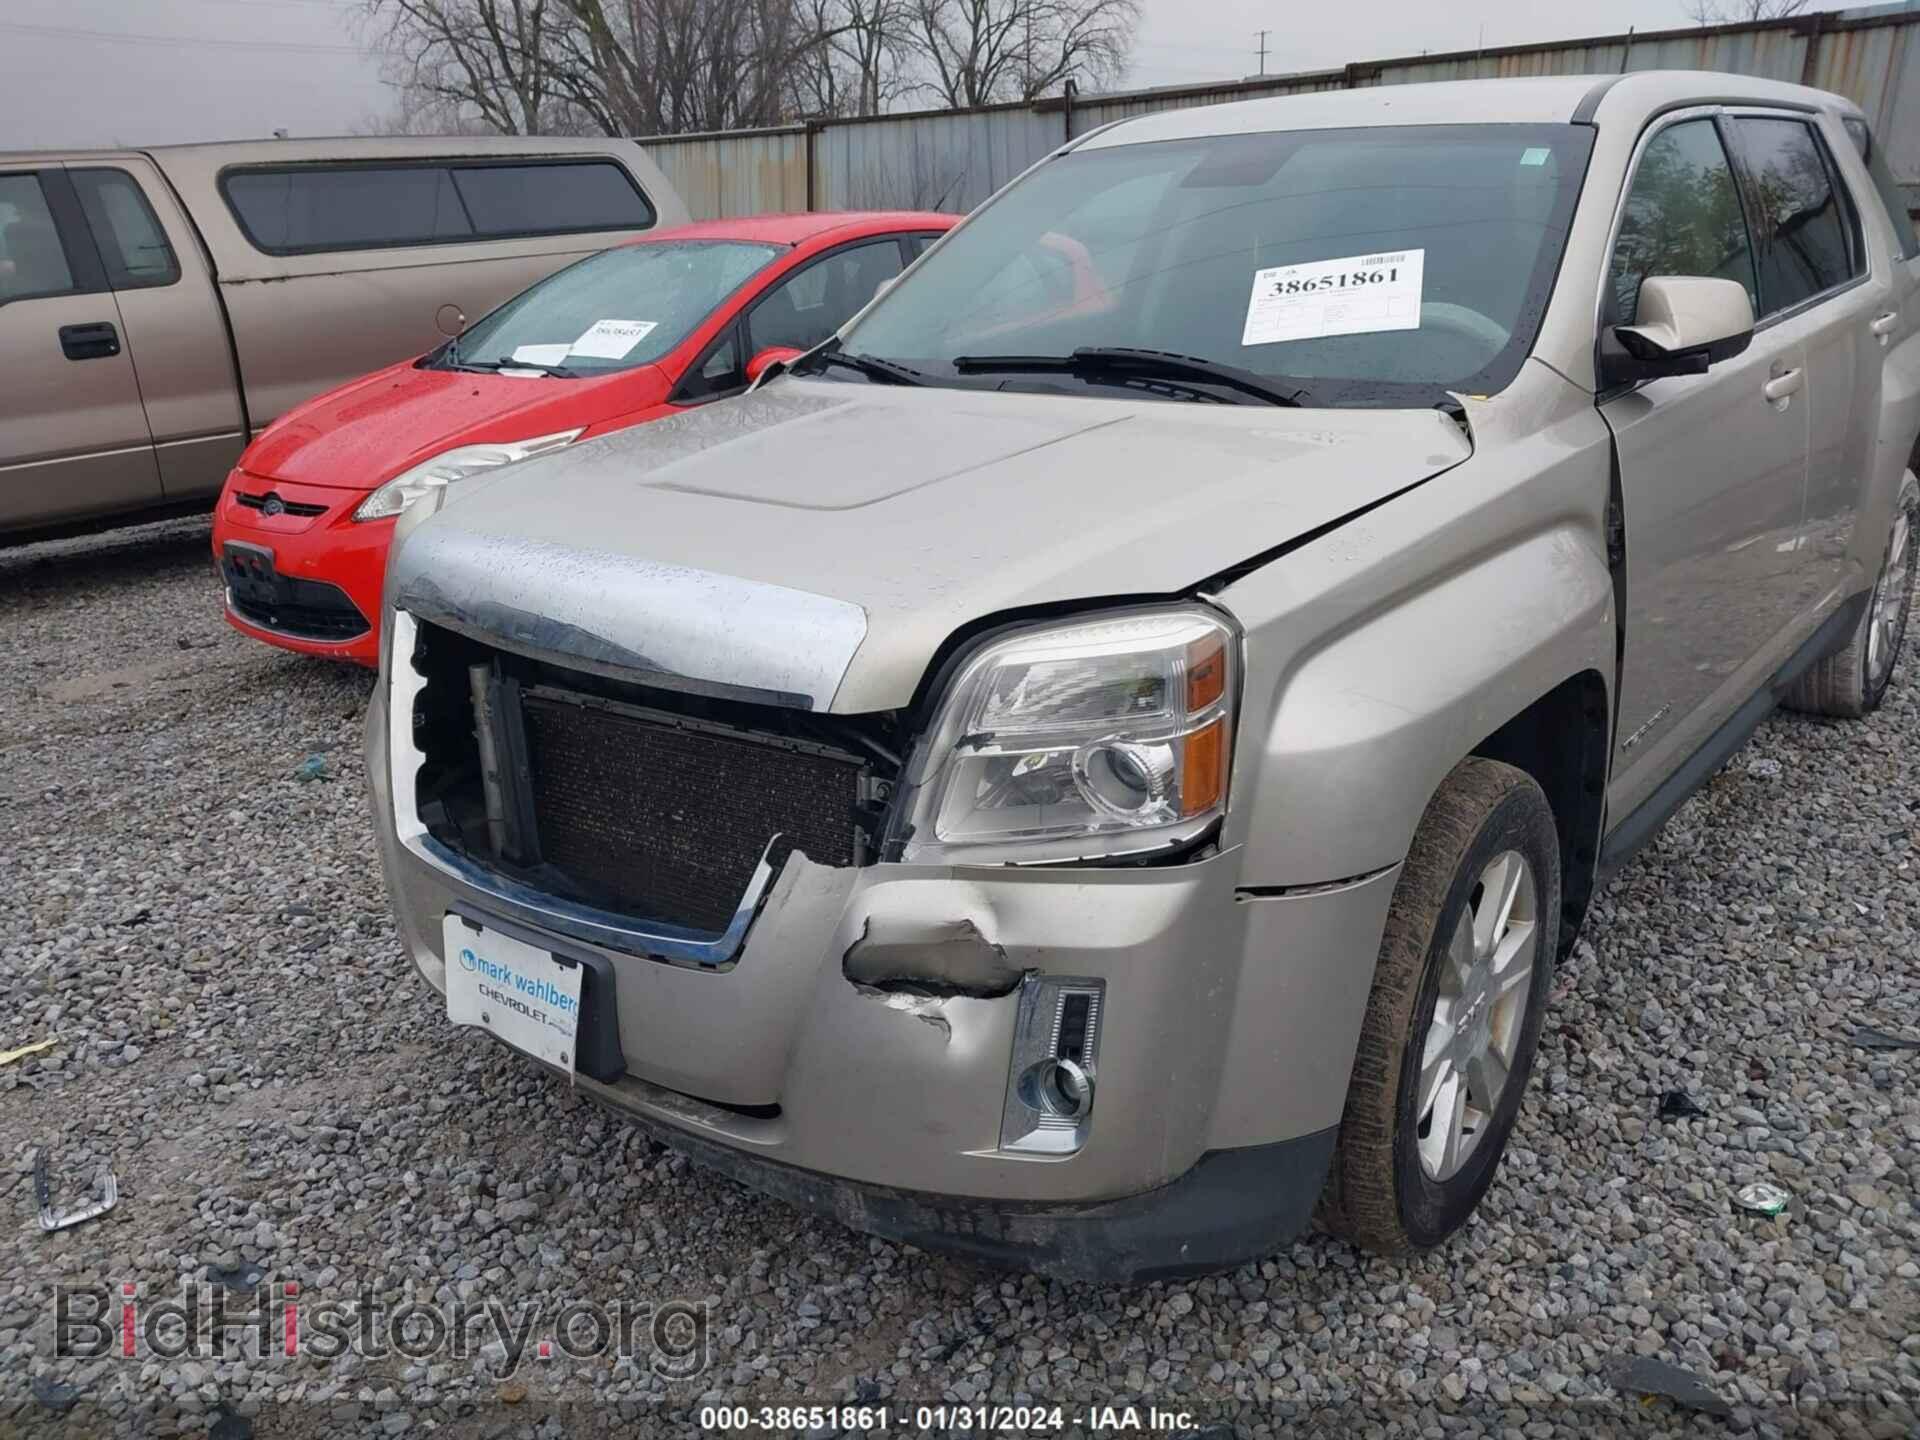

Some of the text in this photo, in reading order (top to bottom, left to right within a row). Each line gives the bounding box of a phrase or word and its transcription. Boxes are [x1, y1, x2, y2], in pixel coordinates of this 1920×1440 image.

[1269, 268, 1400, 297] 38651861
[477, 957, 512, 983] mark
[479, 983, 549, 1025] CHEVROLET
